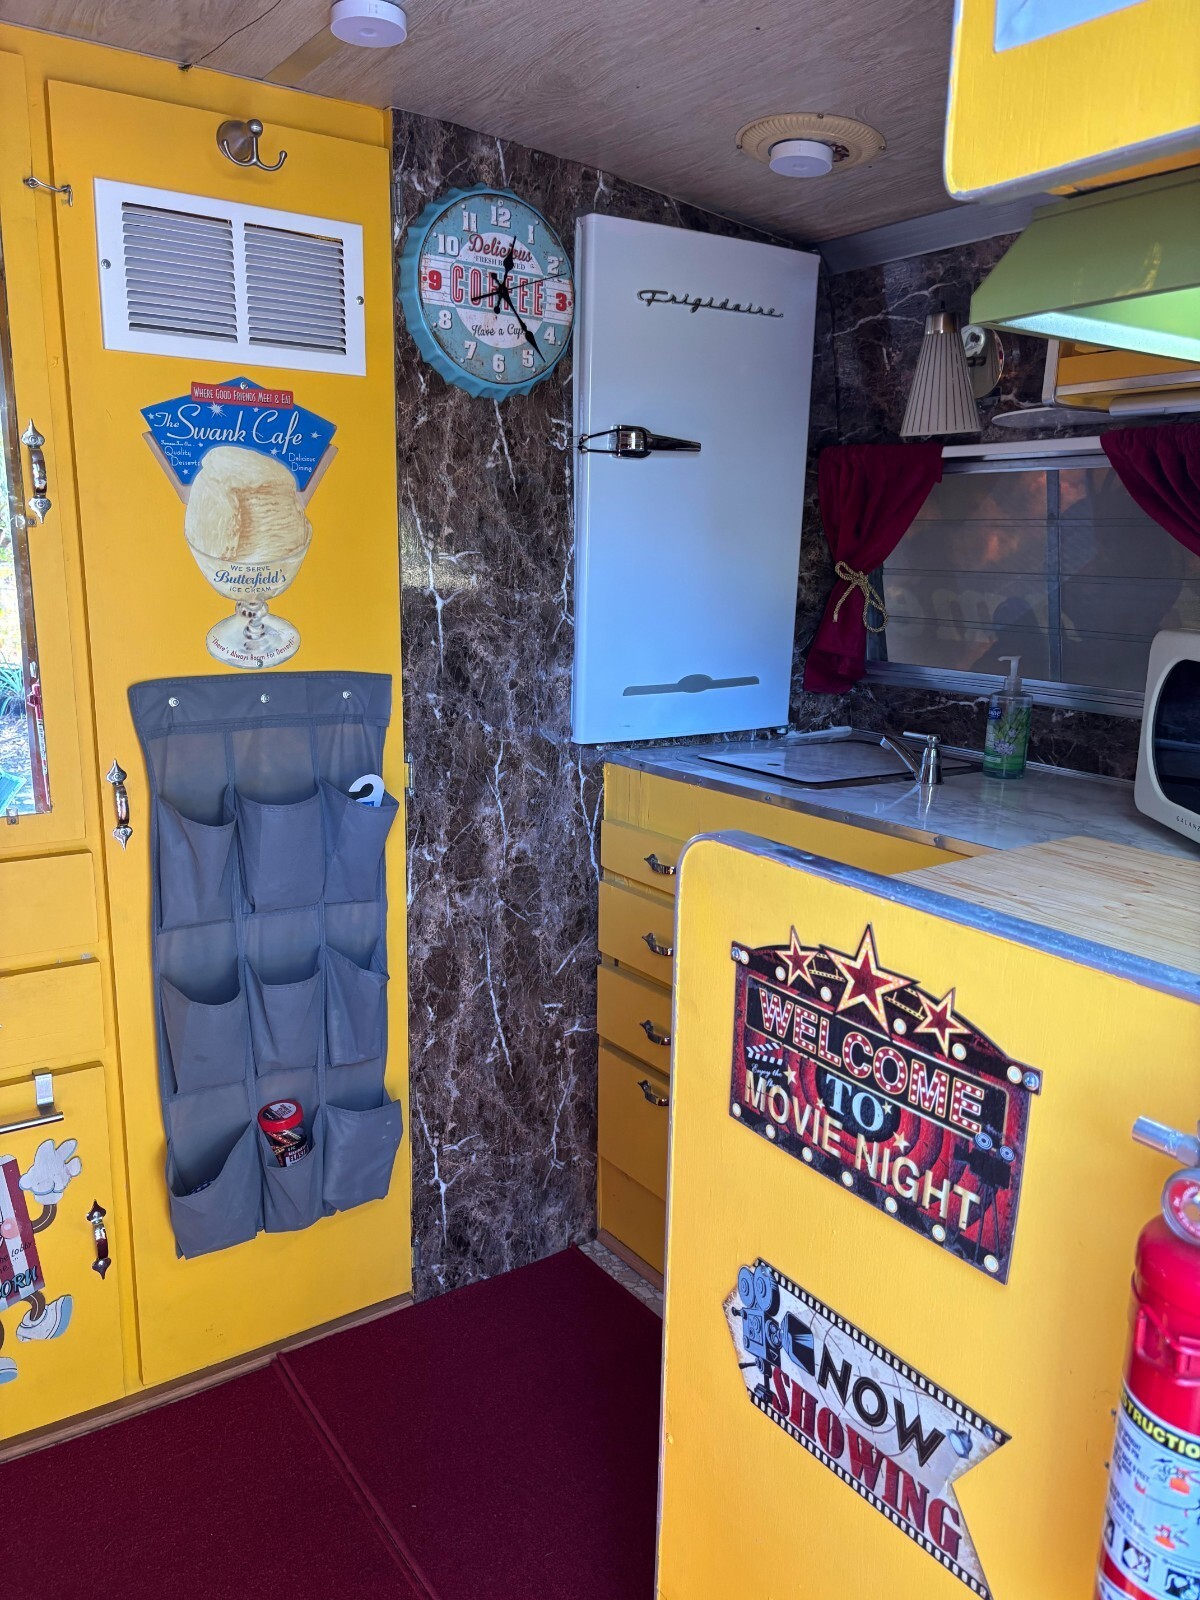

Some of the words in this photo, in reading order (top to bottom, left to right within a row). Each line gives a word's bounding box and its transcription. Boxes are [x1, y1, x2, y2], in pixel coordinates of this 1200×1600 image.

[462, 211, 478, 233] 11
[490, 204, 511, 229] 12
[527, 224, 535, 245] 1
[437, 233, 460, 257] 10
[475, 255, 497, 266] FRESH
[547, 256, 561, 275] 2
[428, 269, 442, 291] 9
[452, 265, 544, 316] COFFEE
[555, 292, 567, 312] 3
[636, 289, 784, 318] Frigidaire
[438, 309, 453, 330] 8
[471, 323, 496, 337] Have
[498, 326, 505, 335] a
[543, 325, 556, 345] 4
[464, 340, 477, 361] 7
[521, 349, 535, 368] 5
[492, 353, 505, 373] 6
[193, 386, 214, 399] WHERE
[215, 388, 232, 400] GOOD
[233, 390, 256, 402] FRIENDS
[257, 393, 272, 404] MEET
[274, 395, 280, 404] &
[281, 395, 291, 405] EAT
[153, 412, 180, 428] The
[166, 403, 246, 442] Swank
[252, 409, 303, 455] Cafe
[164, 445, 192, 458] Quality
[171, 456, 201, 467] Desserts
[288, 453, 316, 463] Delicious
[291, 462, 313, 473] Dining
[213, 568, 287, 588] Butterfield's
[230, 564, 243, 572] WE
[246, 565, 271, 573] SERVE
[244, 586, 272, 594] CREAM
[230, 650, 249, 662] Always
[250, 653, 266, 661] Room
[751, 1062, 771, 1079] Enjoy
[758, 987, 985, 1135] WELCOME
[825, 1072, 885, 1132] TO
[745, 1069, 843, 1160] MOVIE
[854, 1132, 981, 1231] NIGHT
[0, 1265, 39, 1299] ORN
[817, 1342, 946, 1468] NOW
[771, 1365, 963, 1561] SHOWING
